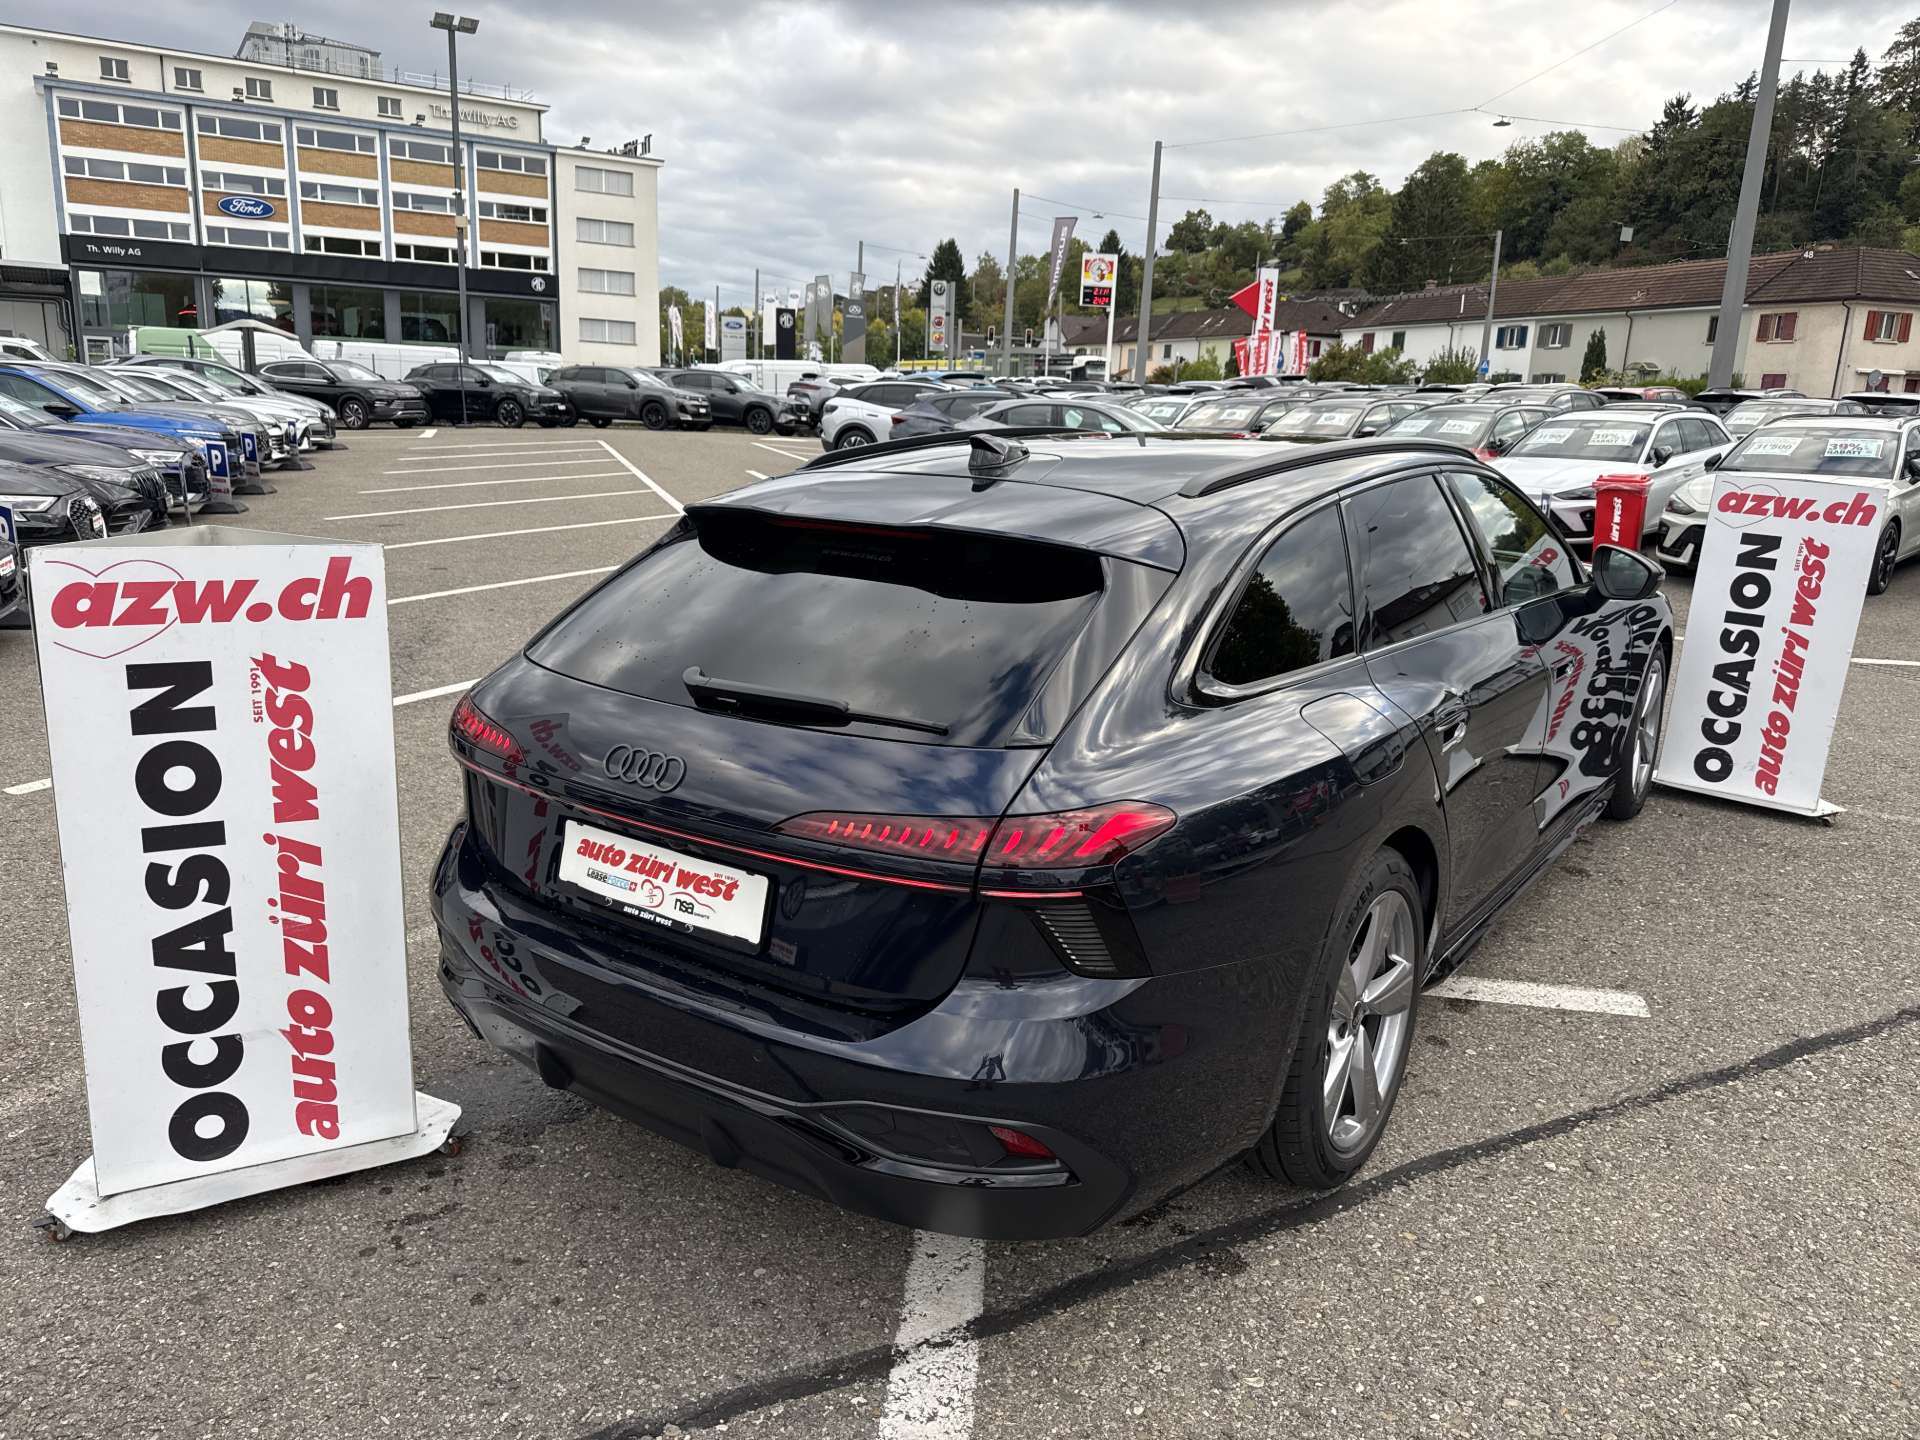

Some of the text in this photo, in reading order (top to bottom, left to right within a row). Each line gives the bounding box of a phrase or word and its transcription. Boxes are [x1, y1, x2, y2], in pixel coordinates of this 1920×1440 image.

[459, 108, 490, 128] Willy
[496, 112, 519, 129] AG
[229, 198, 264, 215] Ford
[86, 244, 142, 257] Th. Willy AG
[1803, 250, 1814, 259] 48
[1264, 279, 1274, 314] west
[779, 312, 794, 328] MG
[211, 449, 222, 472] P
[244, 438, 253, 457] P
[1717, 491, 1878, 527] azw.ch
[51, 556, 373, 629] azw.ch
[1693, 532, 1783, 783] OCCASION
[1754, 535, 1831, 796] auto züri west
[250, 667, 264, 723] SEIT 1991
[576, 837, 740, 901] auto züri west
[250, 652, 341, 1141] auto züri west
[673, 897, 695, 915] nsa
[125, 661, 250, 1162] OCCASION
[623, 905, 673, 927] auto züri west
